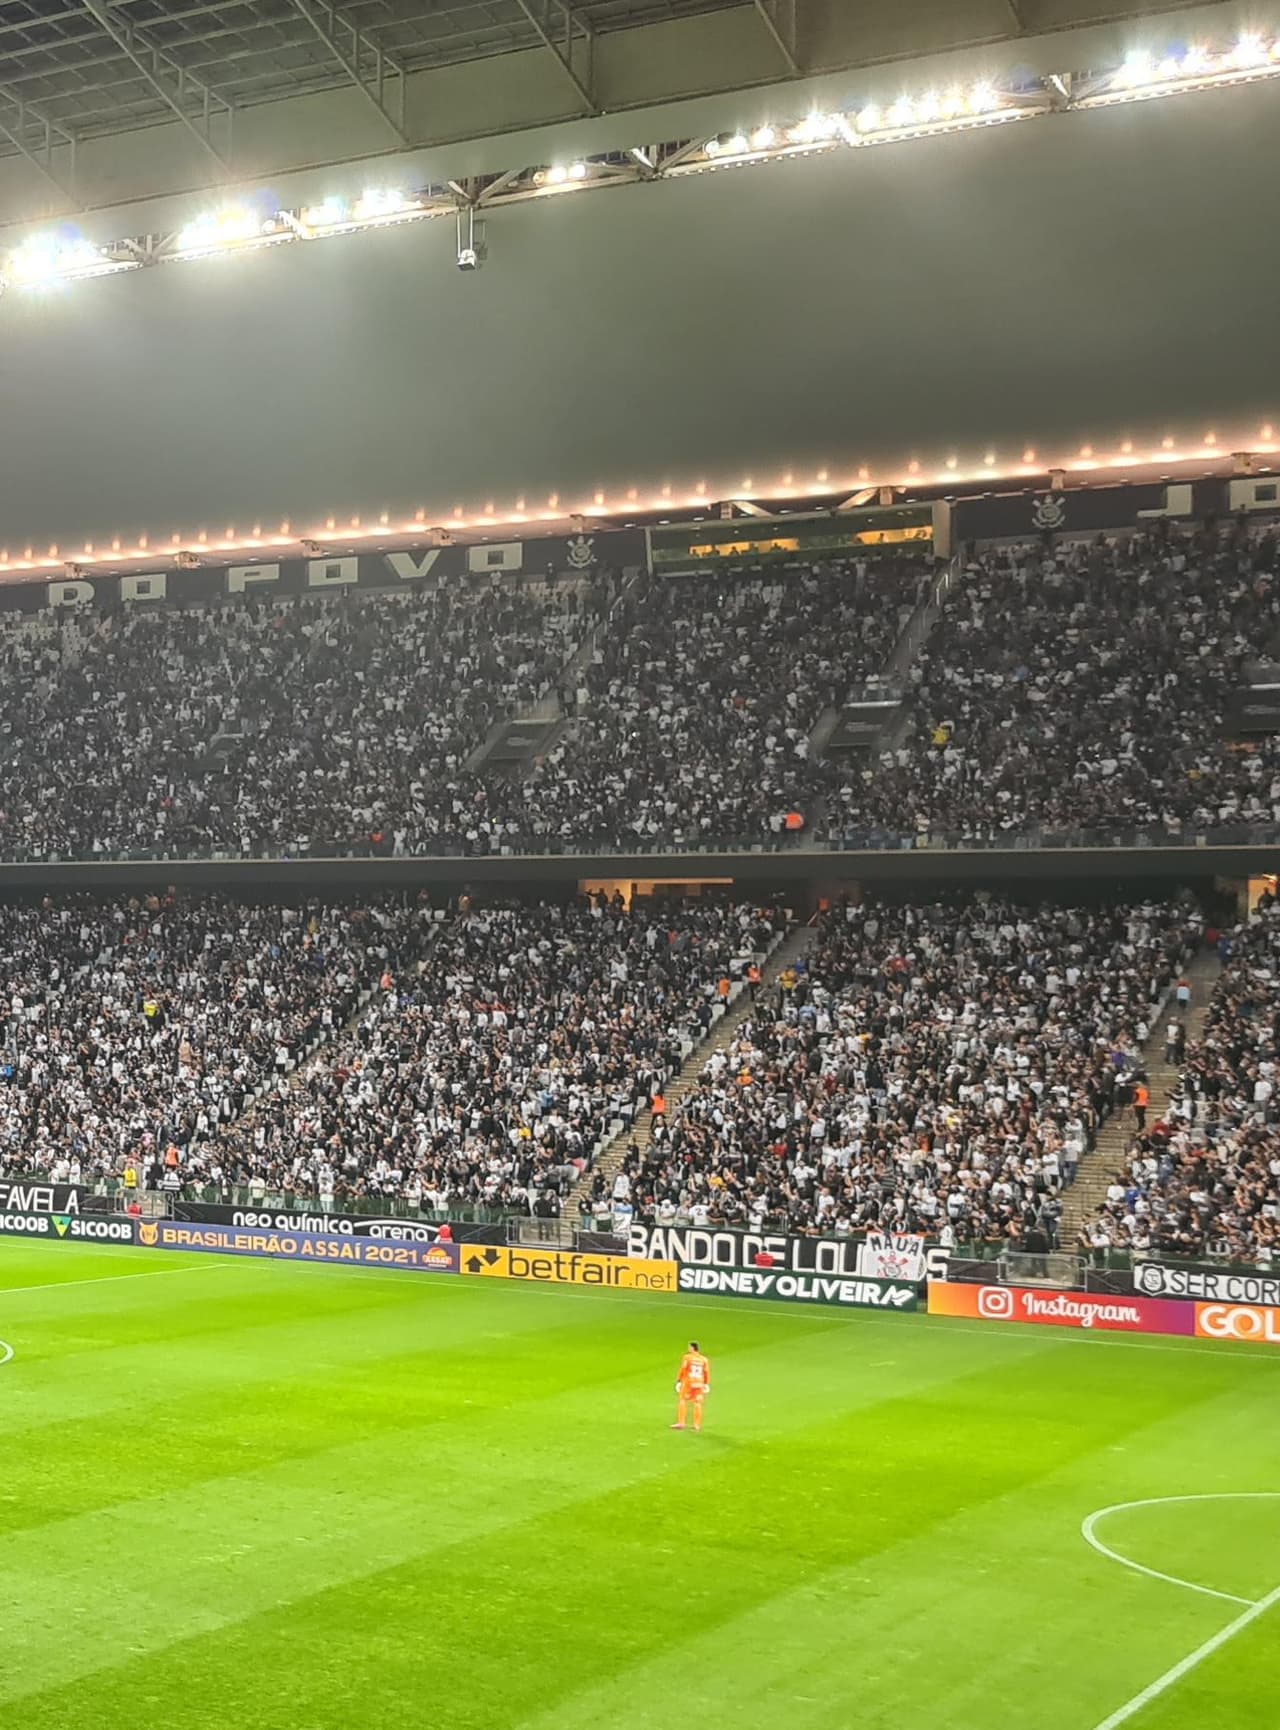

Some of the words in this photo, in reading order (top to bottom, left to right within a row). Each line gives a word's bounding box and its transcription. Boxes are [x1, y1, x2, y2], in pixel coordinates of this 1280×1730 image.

[48, 573, 167, 607] DO
[228, 542, 523, 593] POVO
[71, 1219, 132, 1239] SICOOB
[233, 1211, 271, 1229] neo
[275, 1212, 353, 1236] química
[369, 1224, 428, 1243] arena
[162, 1227, 297, 1255] BRASILEIRÃO
[300, 1236, 362, 1260] ASSAÍ
[365, 1244, 418, 1265] 2021
[628, 1225, 736, 1266] BANDO
[743, 1234, 787, 1270] DE
[792, 1238, 952, 1283] LOUS
[508, 1250, 673, 1290] betfair.net
[680, 1268, 776, 1295] SIDNEY
[1171, 1271, 1218, 1297] SER
[1021, 1292, 1140, 1328] Instagram
